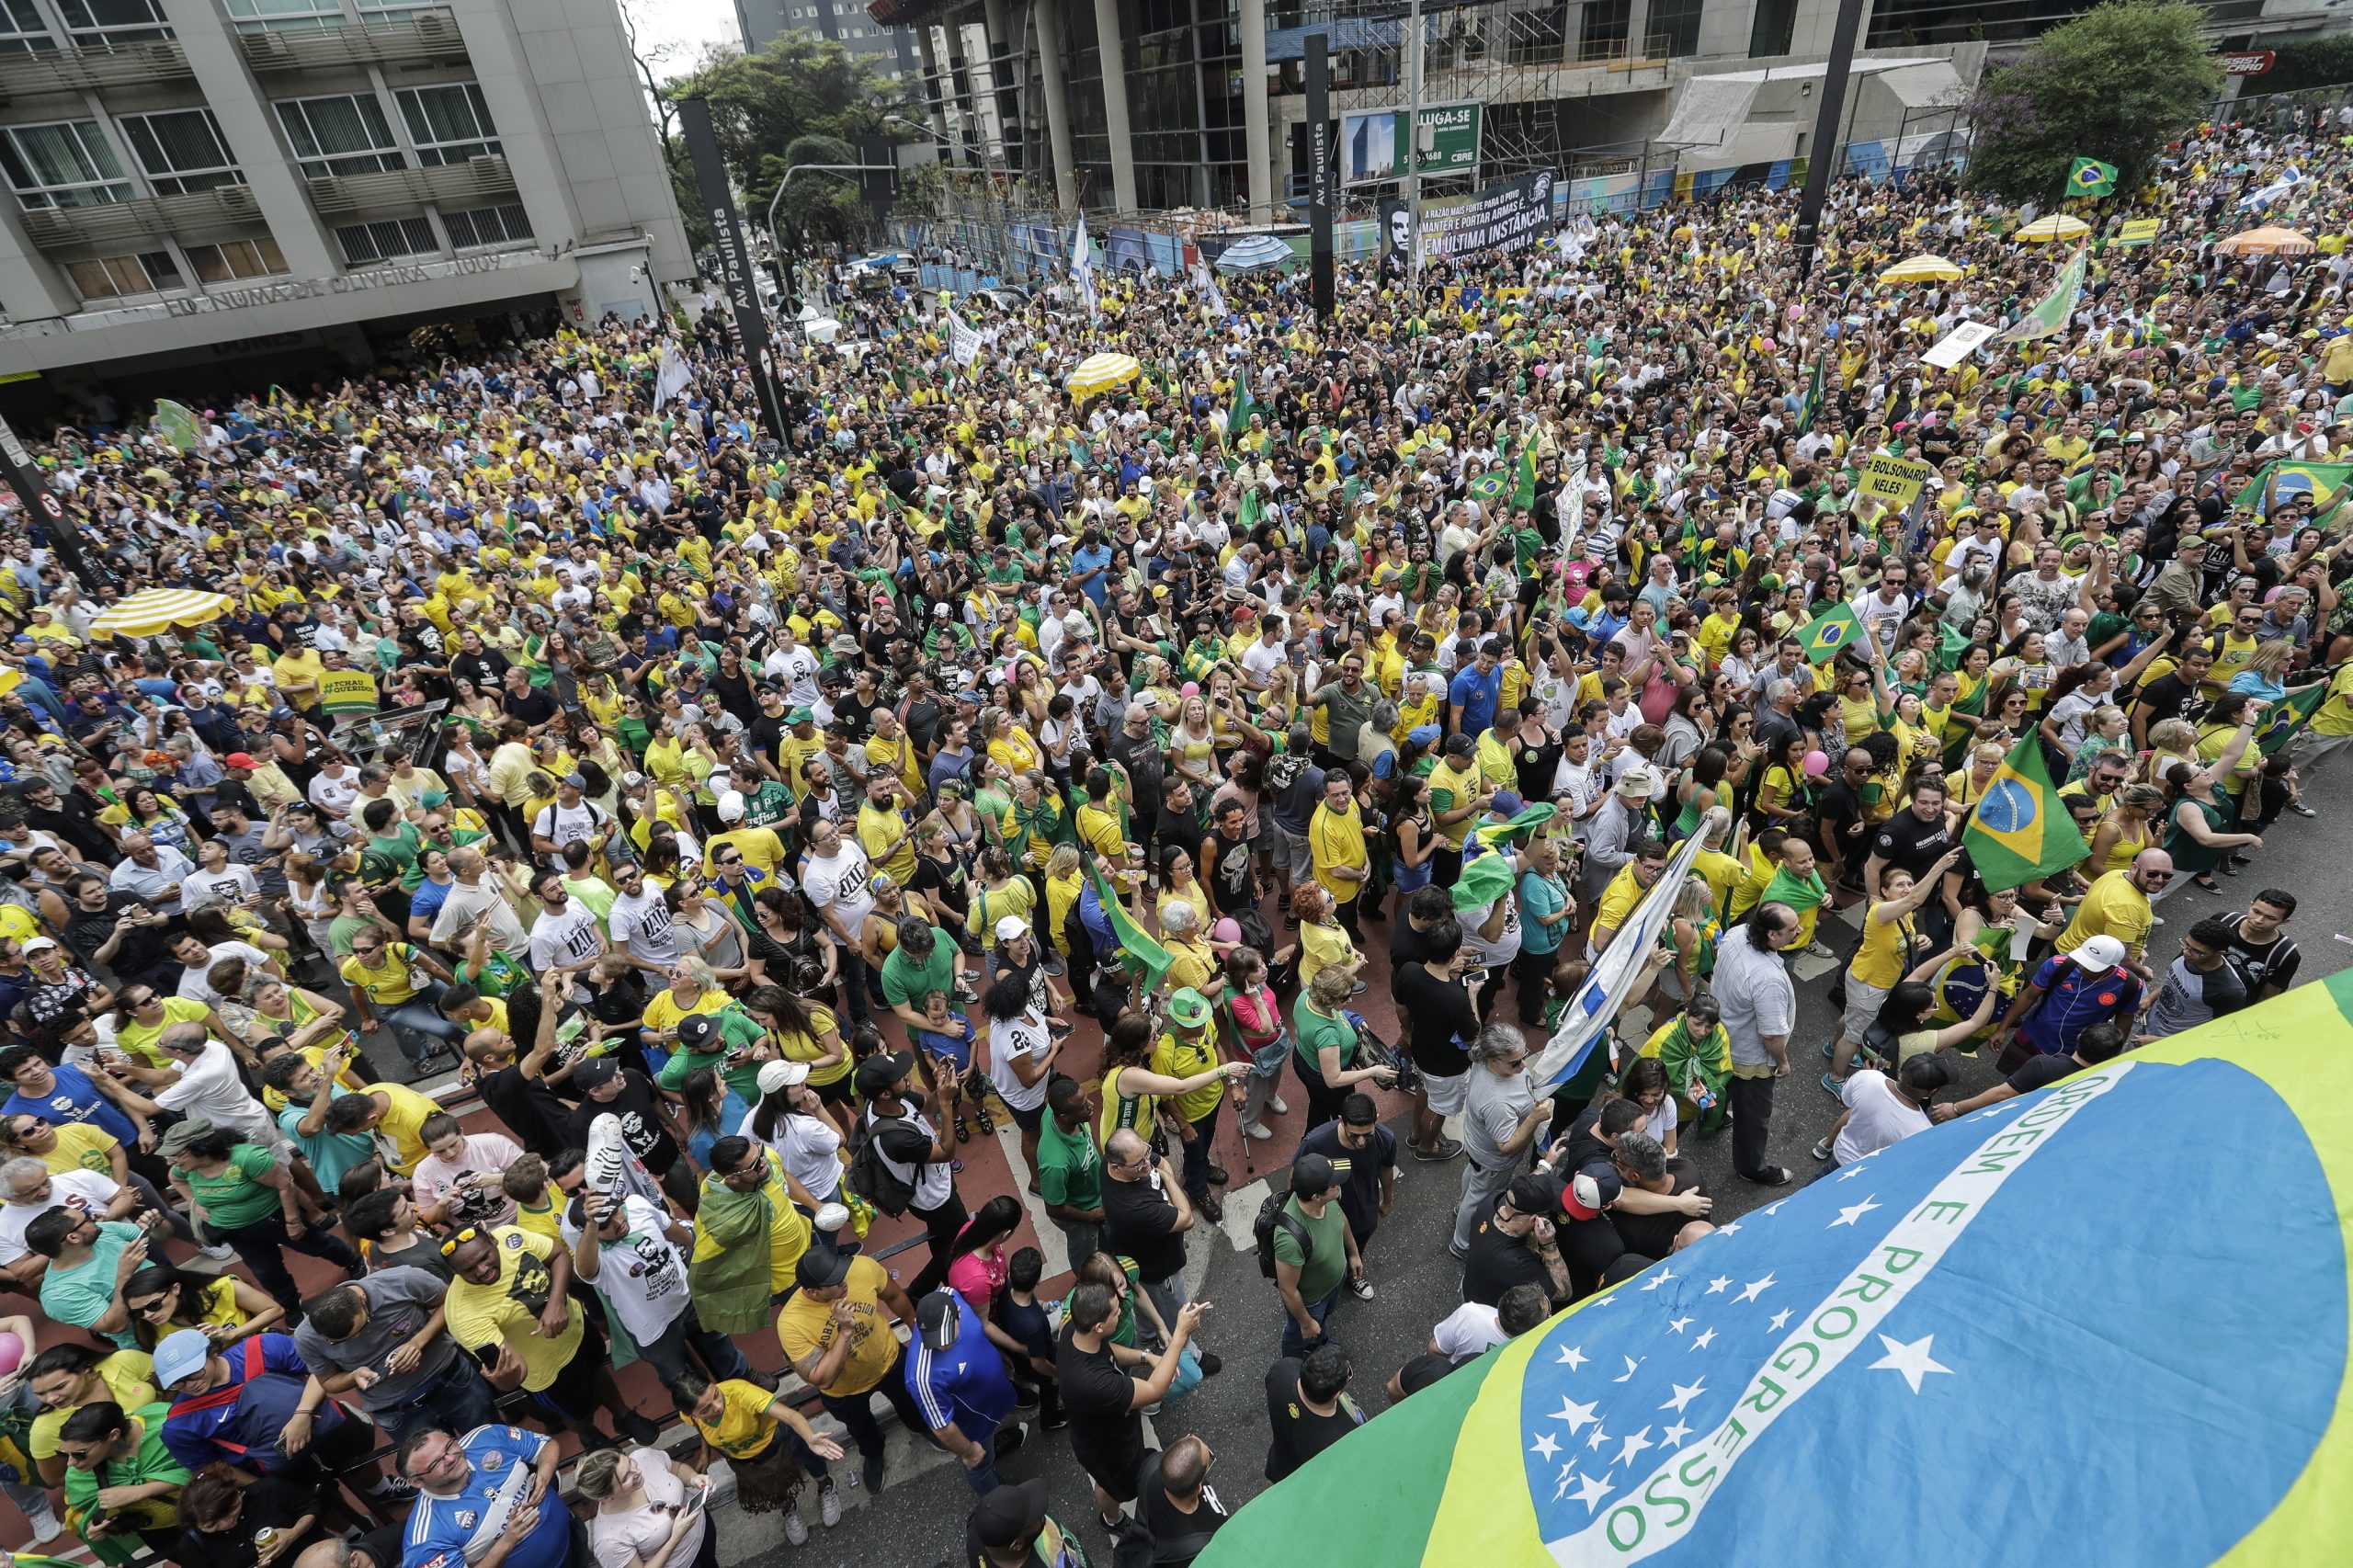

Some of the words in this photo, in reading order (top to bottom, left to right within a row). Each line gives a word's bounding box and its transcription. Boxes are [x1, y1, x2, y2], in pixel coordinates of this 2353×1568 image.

[2221, 55, 2265, 65] SSIST
[2226, 62, 2265, 73] CARD
[1417, 109, 1471, 126] LUGA-SE
[1314, 122, 1324, 183] Paulista
[1451, 152, 1473, 163] CBRE
[1316, 187, 1325, 207] Av.
[1430, 207, 1449, 219] RAZÃO
[1449, 205, 1465, 216] MAIS
[1465, 201, 1483, 213] FORTE
[1483, 198, 1499, 210] PARA
[1505, 189, 1519, 202] POVO
[1421, 219, 1453, 234] MANTER
[1455, 218, 1460, 230] E
[1461, 213, 1490, 228] PORTAR
[1491, 202, 1518, 221] ARMAS
[1425, 238, 1442, 256] EM
[1445, 229, 1485, 254] ÚLTIMA
[1488, 204, 1550, 244] INSTÂNCIA,
[713, 208, 743, 282] Paulista
[1527, 231, 1533, 245] A
[331, 265, 431, 294] OLIVEIRA
[735, 285, 751, 309] Av.
[1872, 460, 1927, 483] BOLSONARO
[1871, 478, 1902, 495] NELES
[839, 860, 867, 898] JAIR
[641, 905, 672, 938] JAIR
[1960, 1074, 2110, 1176] ORDEM
[1911, 1199, 1971, 1225] E
[1606, 1244, 1923, 1553] PROGRESSO
